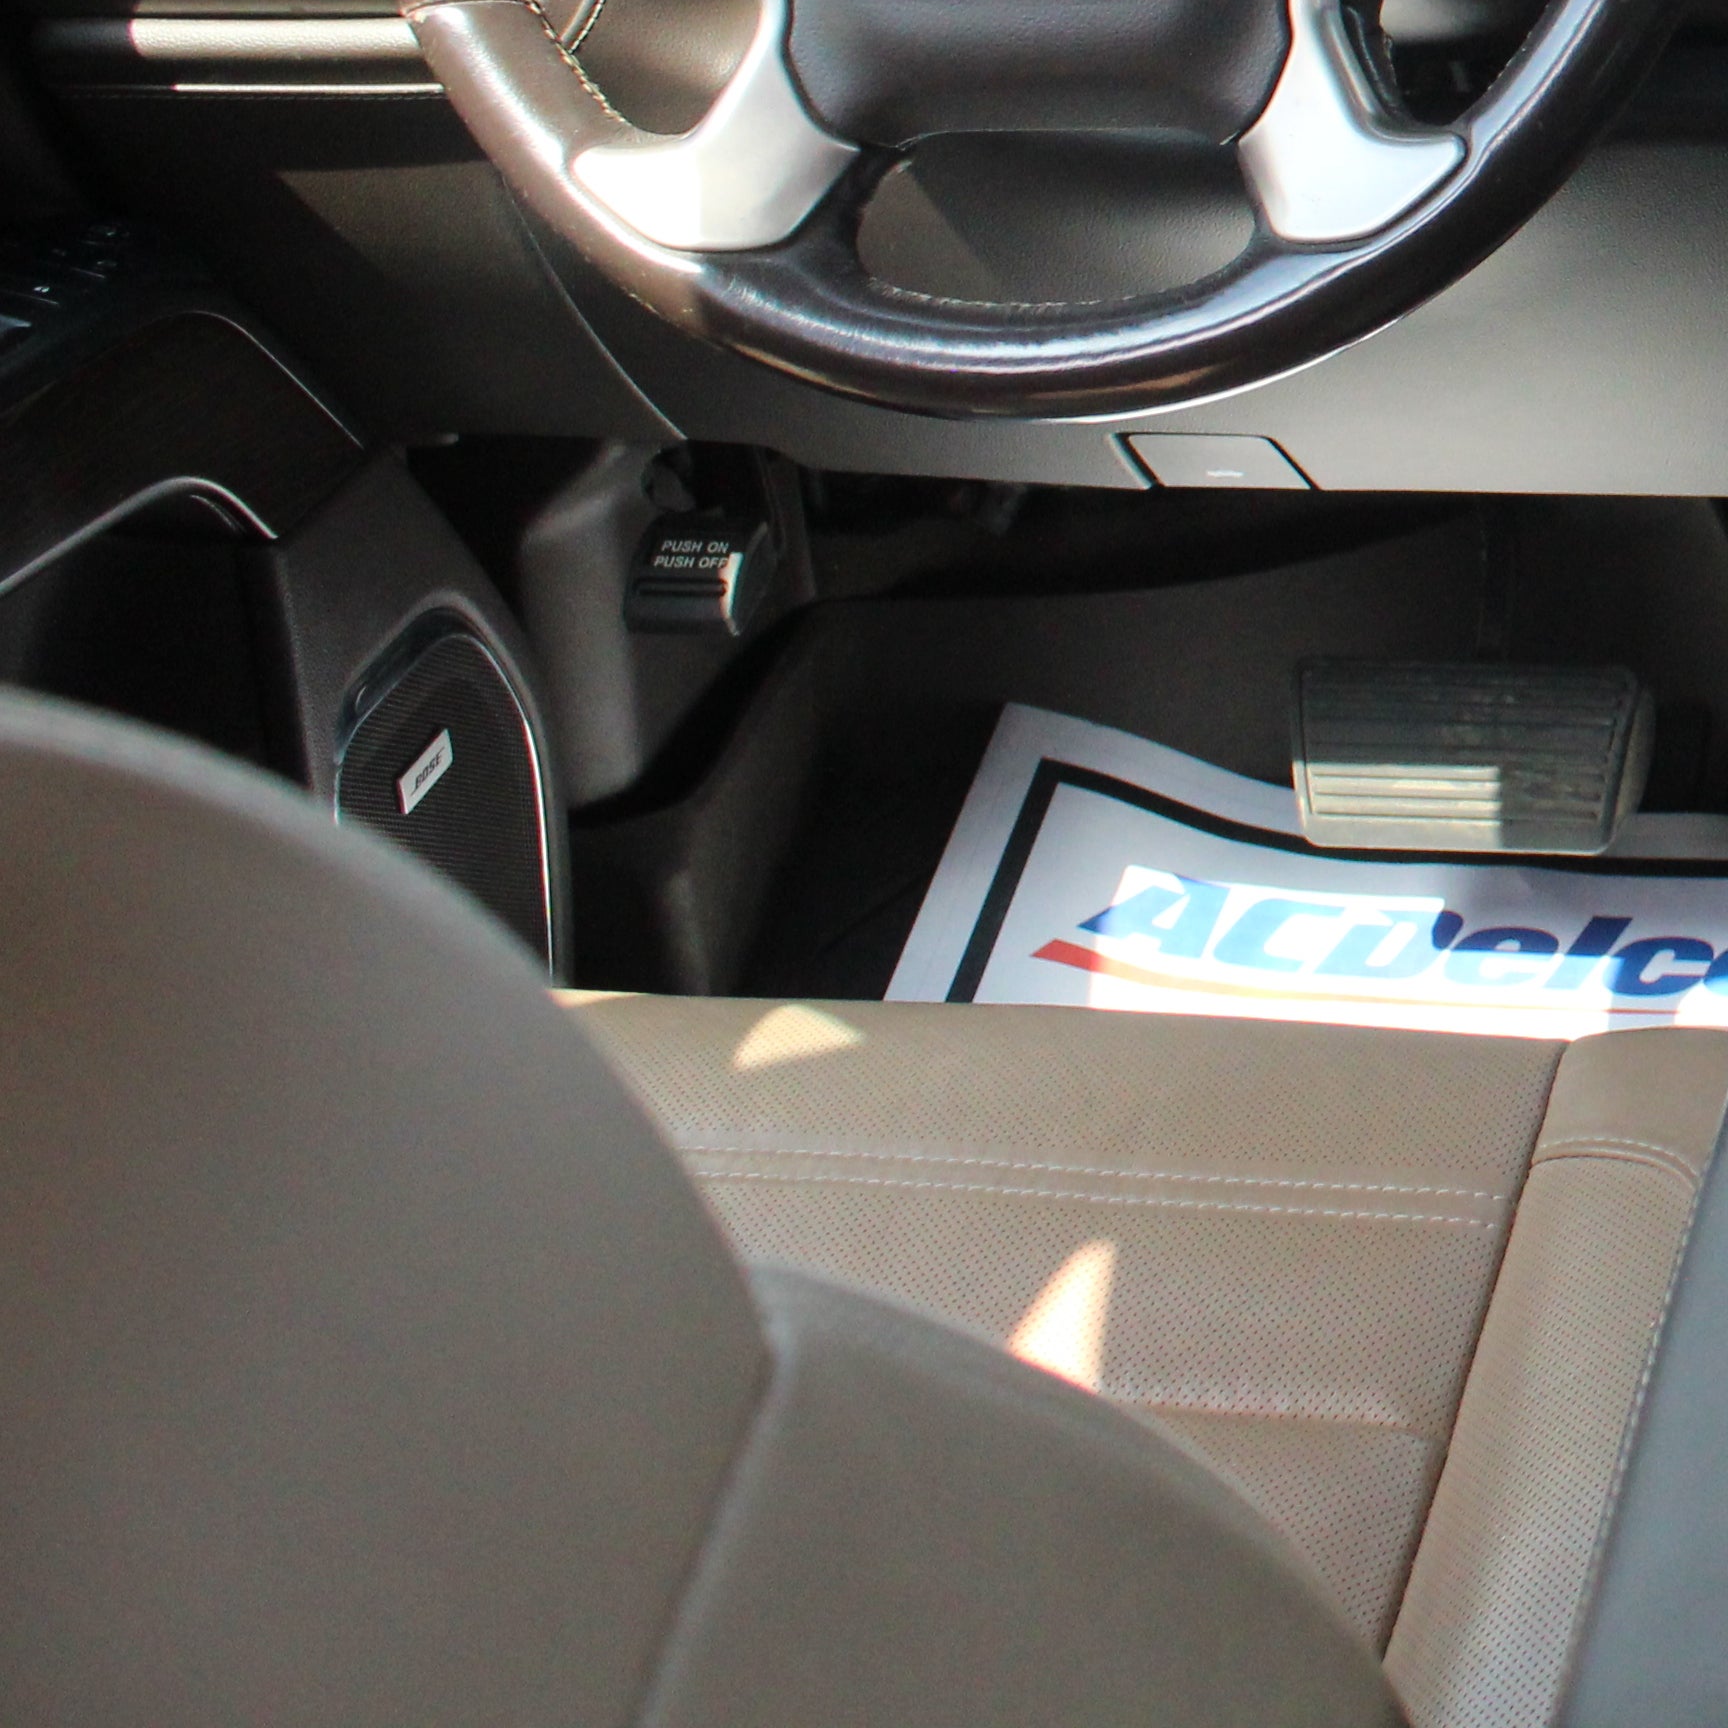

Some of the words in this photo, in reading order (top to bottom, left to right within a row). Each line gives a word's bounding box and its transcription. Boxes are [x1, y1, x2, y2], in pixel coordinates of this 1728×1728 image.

[661, 540, 702, 553] PUSH
[707, 541, 730, 554] ON
[654, 555, 695, 569] PUSH
[698, 556, 729, 569] OFF
[411, 746, 445, 796] BOSE
